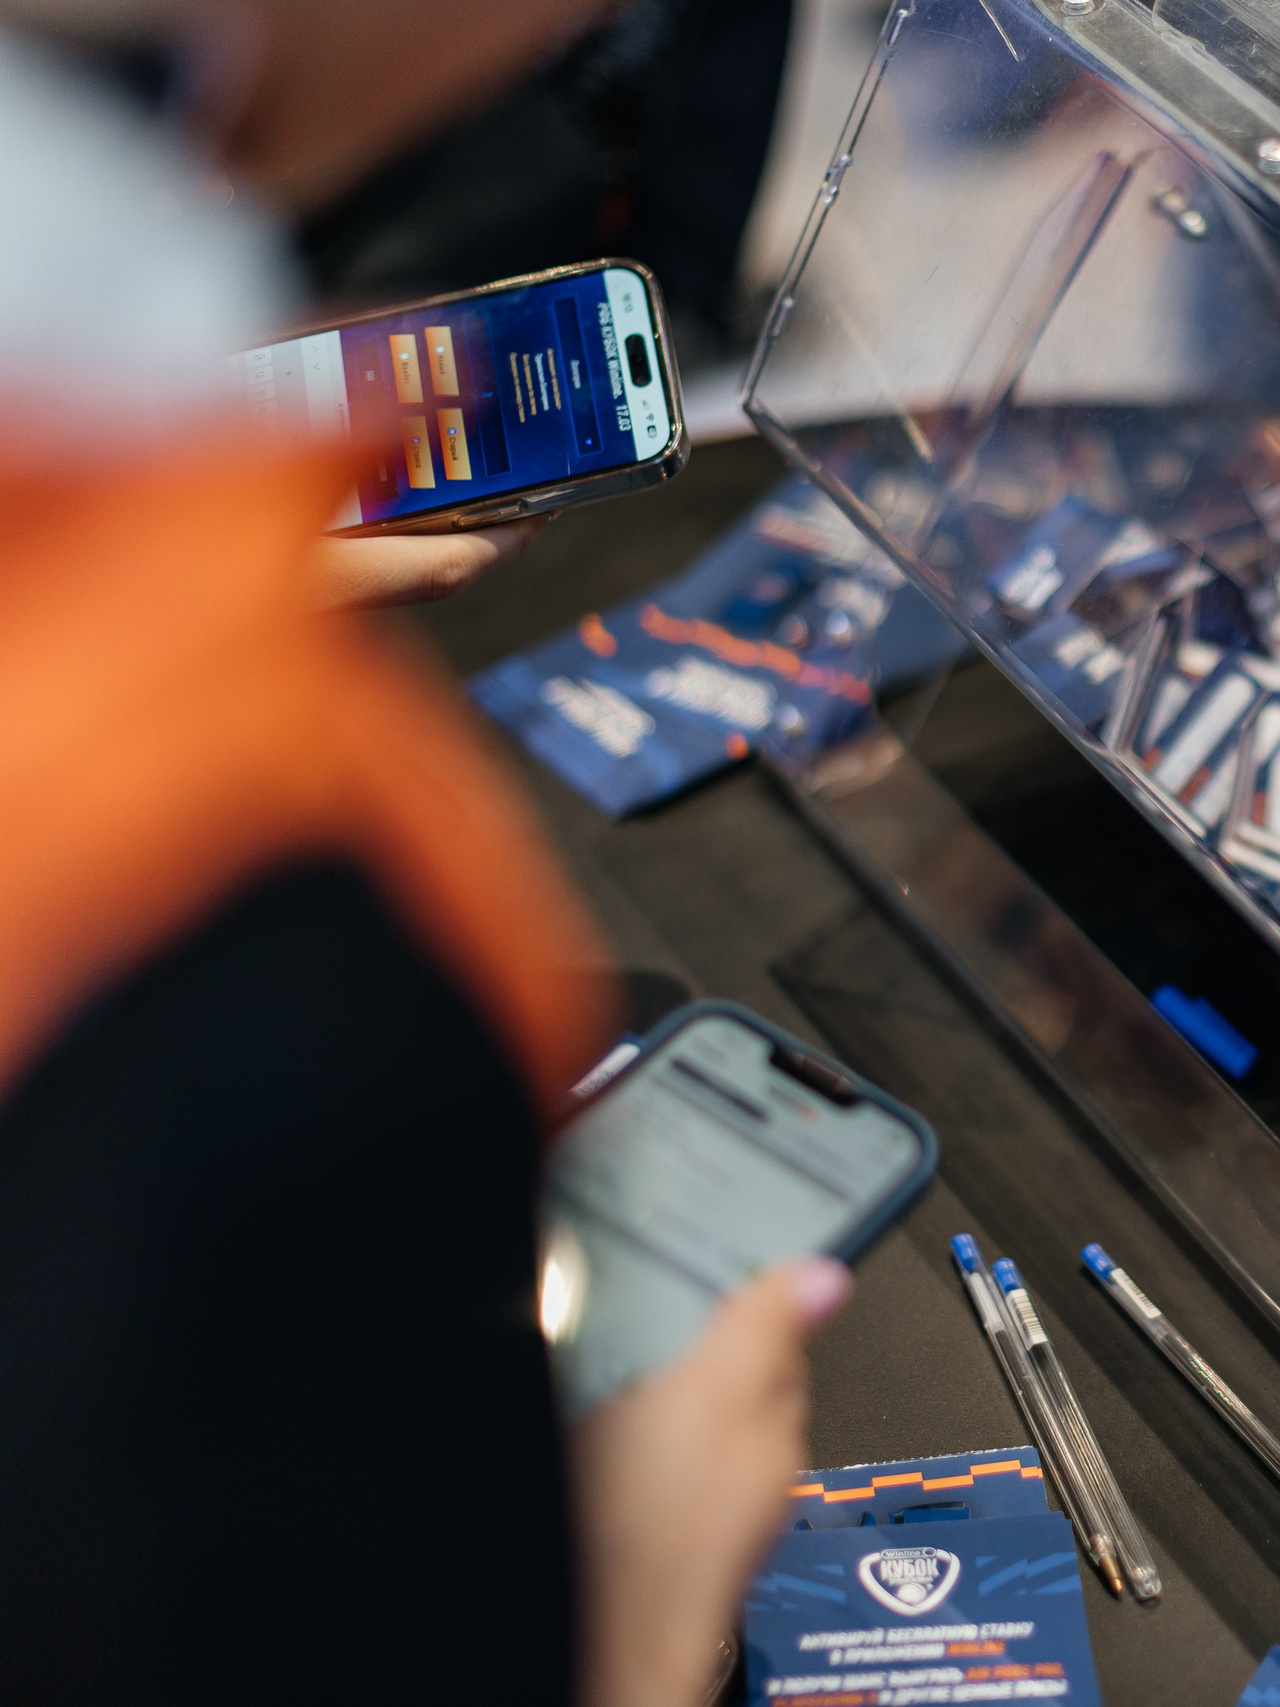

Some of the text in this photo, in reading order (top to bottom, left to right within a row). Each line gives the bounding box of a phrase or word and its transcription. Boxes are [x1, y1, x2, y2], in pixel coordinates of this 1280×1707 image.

[616, 404, 631, 431] 17.03
[880, 1558, 939, 1580] КУБОК
[979, 1621, 1034, 1639] СТАВКУ
